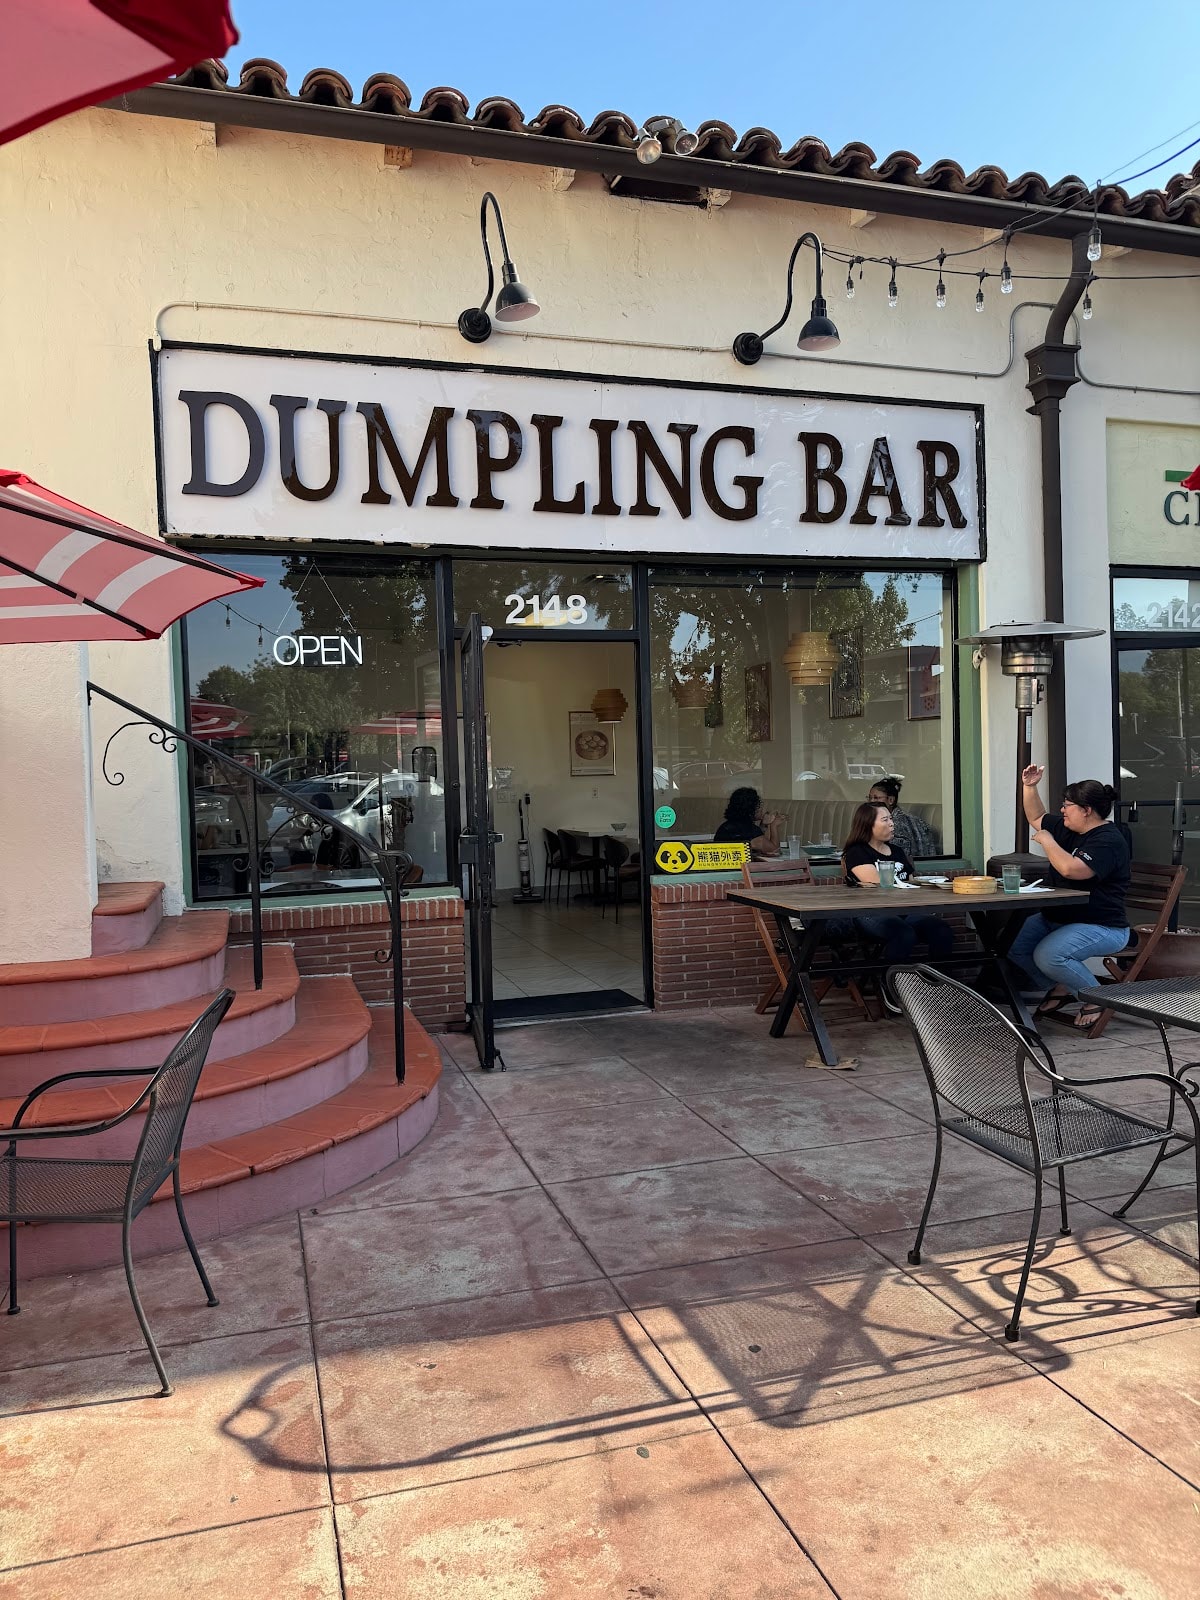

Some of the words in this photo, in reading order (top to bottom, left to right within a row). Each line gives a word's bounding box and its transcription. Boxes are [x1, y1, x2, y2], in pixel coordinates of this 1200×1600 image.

[178, 389, 764, 521] DUMPLING
[797, 431, 968, 529] BAR
[505, 594, 588, 626] 2148
[1147, 602, 1200, 628] 2142
[273, 634, 363, 667] OPEN
[697, 850, 743, 863] 熊猫外卖
